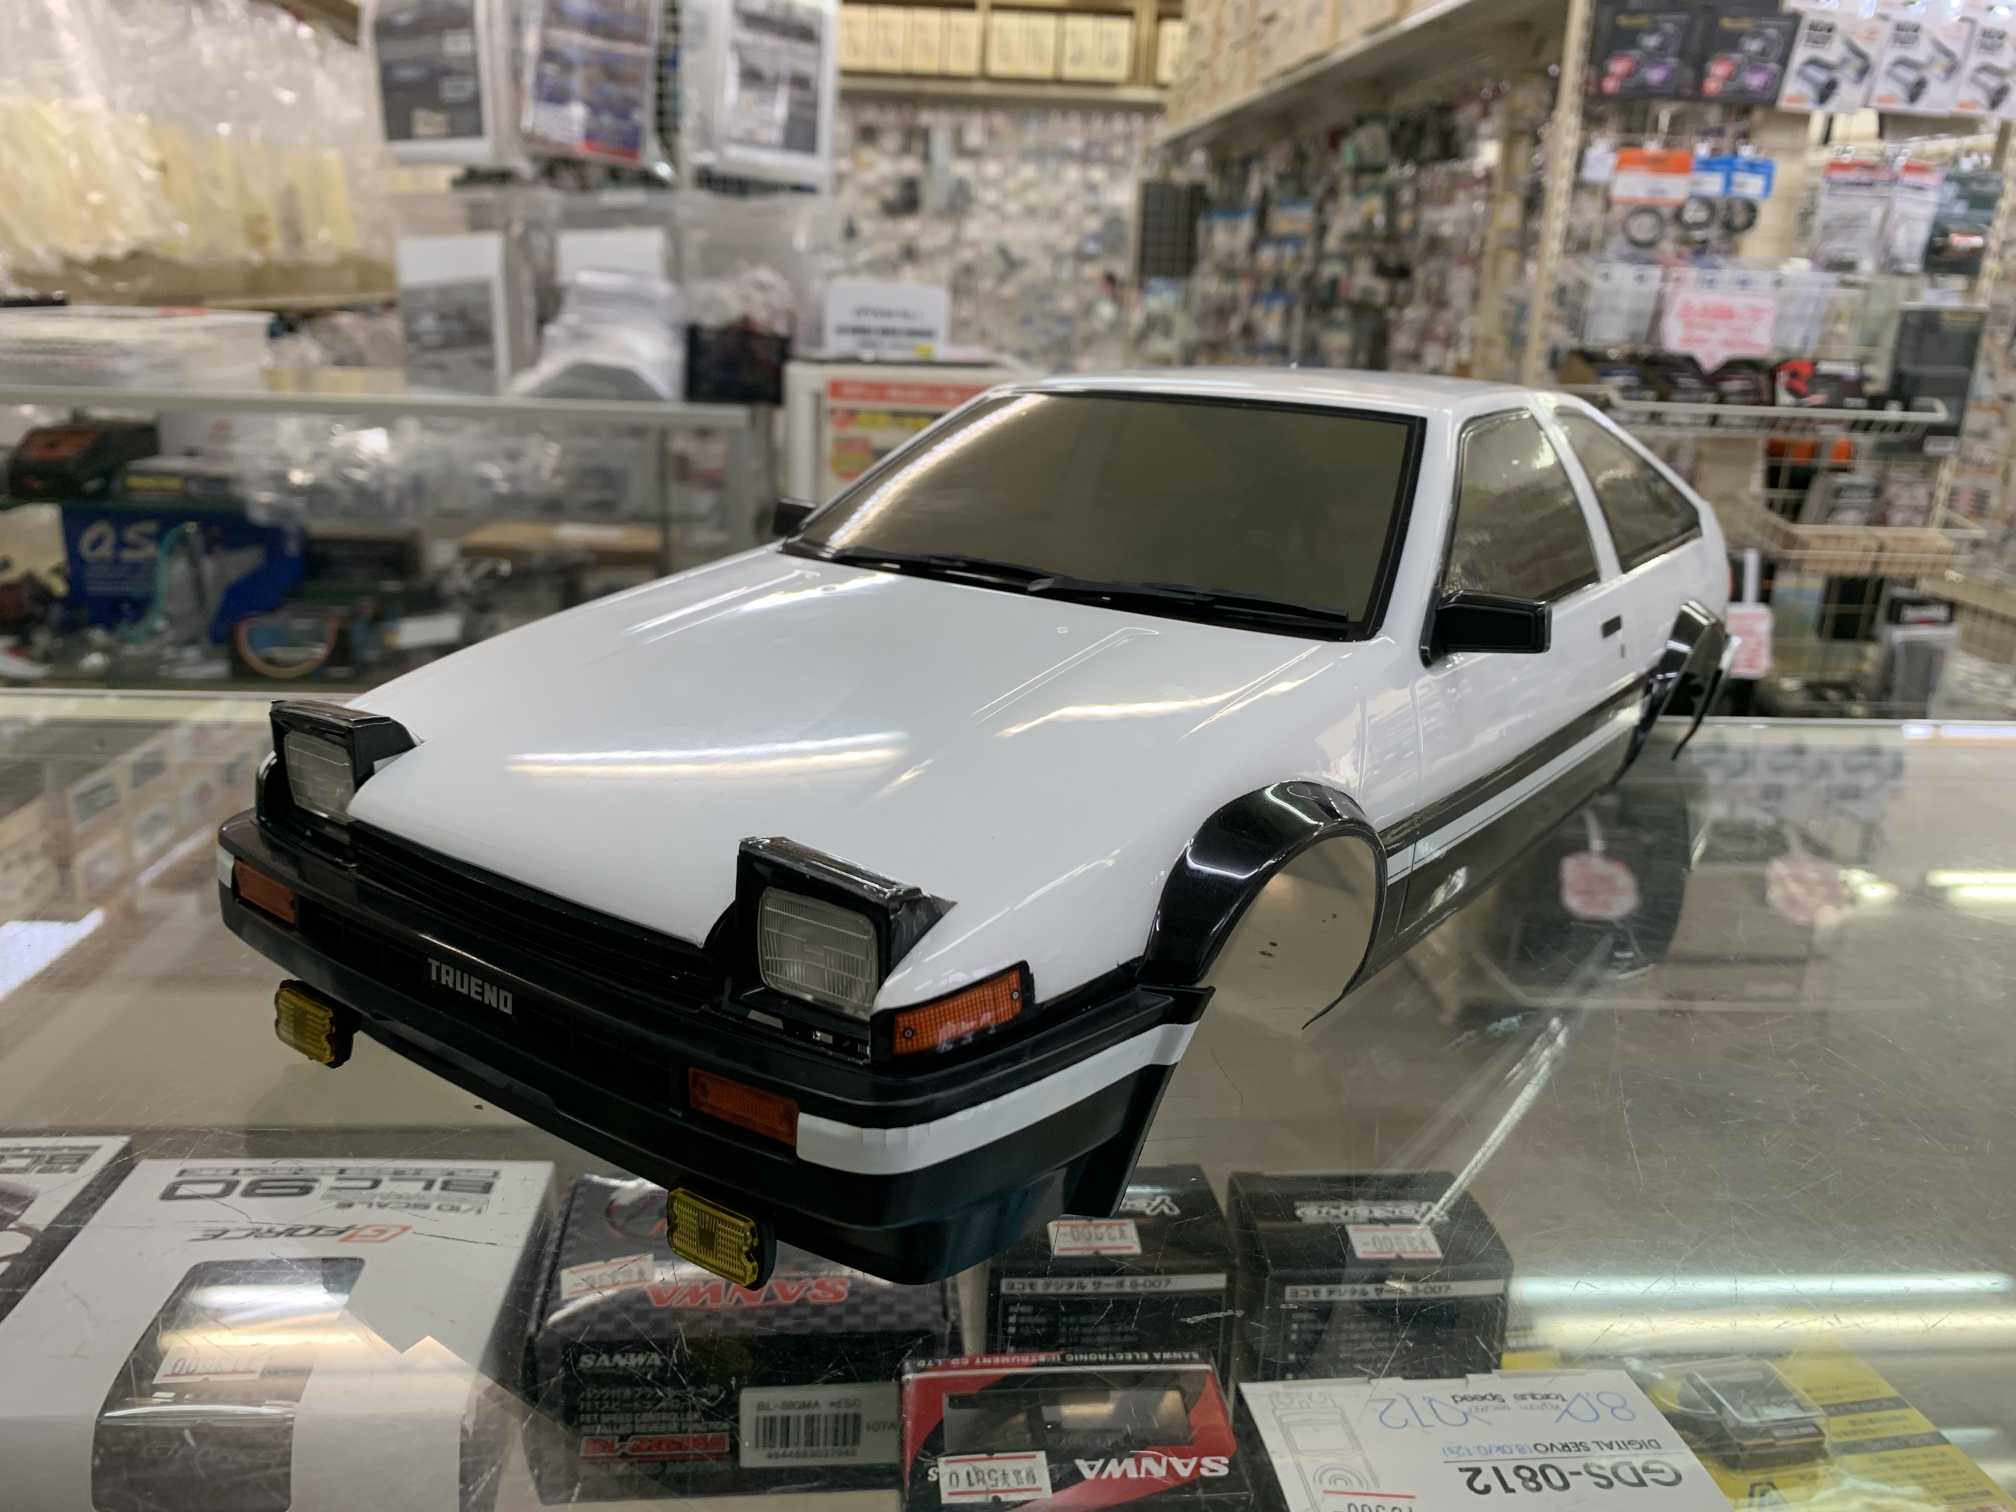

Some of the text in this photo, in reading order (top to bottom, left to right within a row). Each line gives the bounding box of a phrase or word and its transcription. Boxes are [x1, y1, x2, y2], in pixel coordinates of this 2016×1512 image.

[427, 957, 513, 1016] TRUENO
[645, 1277, 850, 1308] SANWA
[576, 1351, 663, 1369] SANWA
[1065, 1351, 1149, 1363] ELECTRONIC
[1152, 1351, 1200, 1361] SANWA
[1450, 1392, 1569, 1405] Torque Speed
[1533, 1440, 1590, 1455] SERVO
[1591, 1439, 1662, 1455] DIGITAL
[1073, 1456, 1231, 1481] SANWA
[1457, 1459, 1684, 1497] GDS-0812
